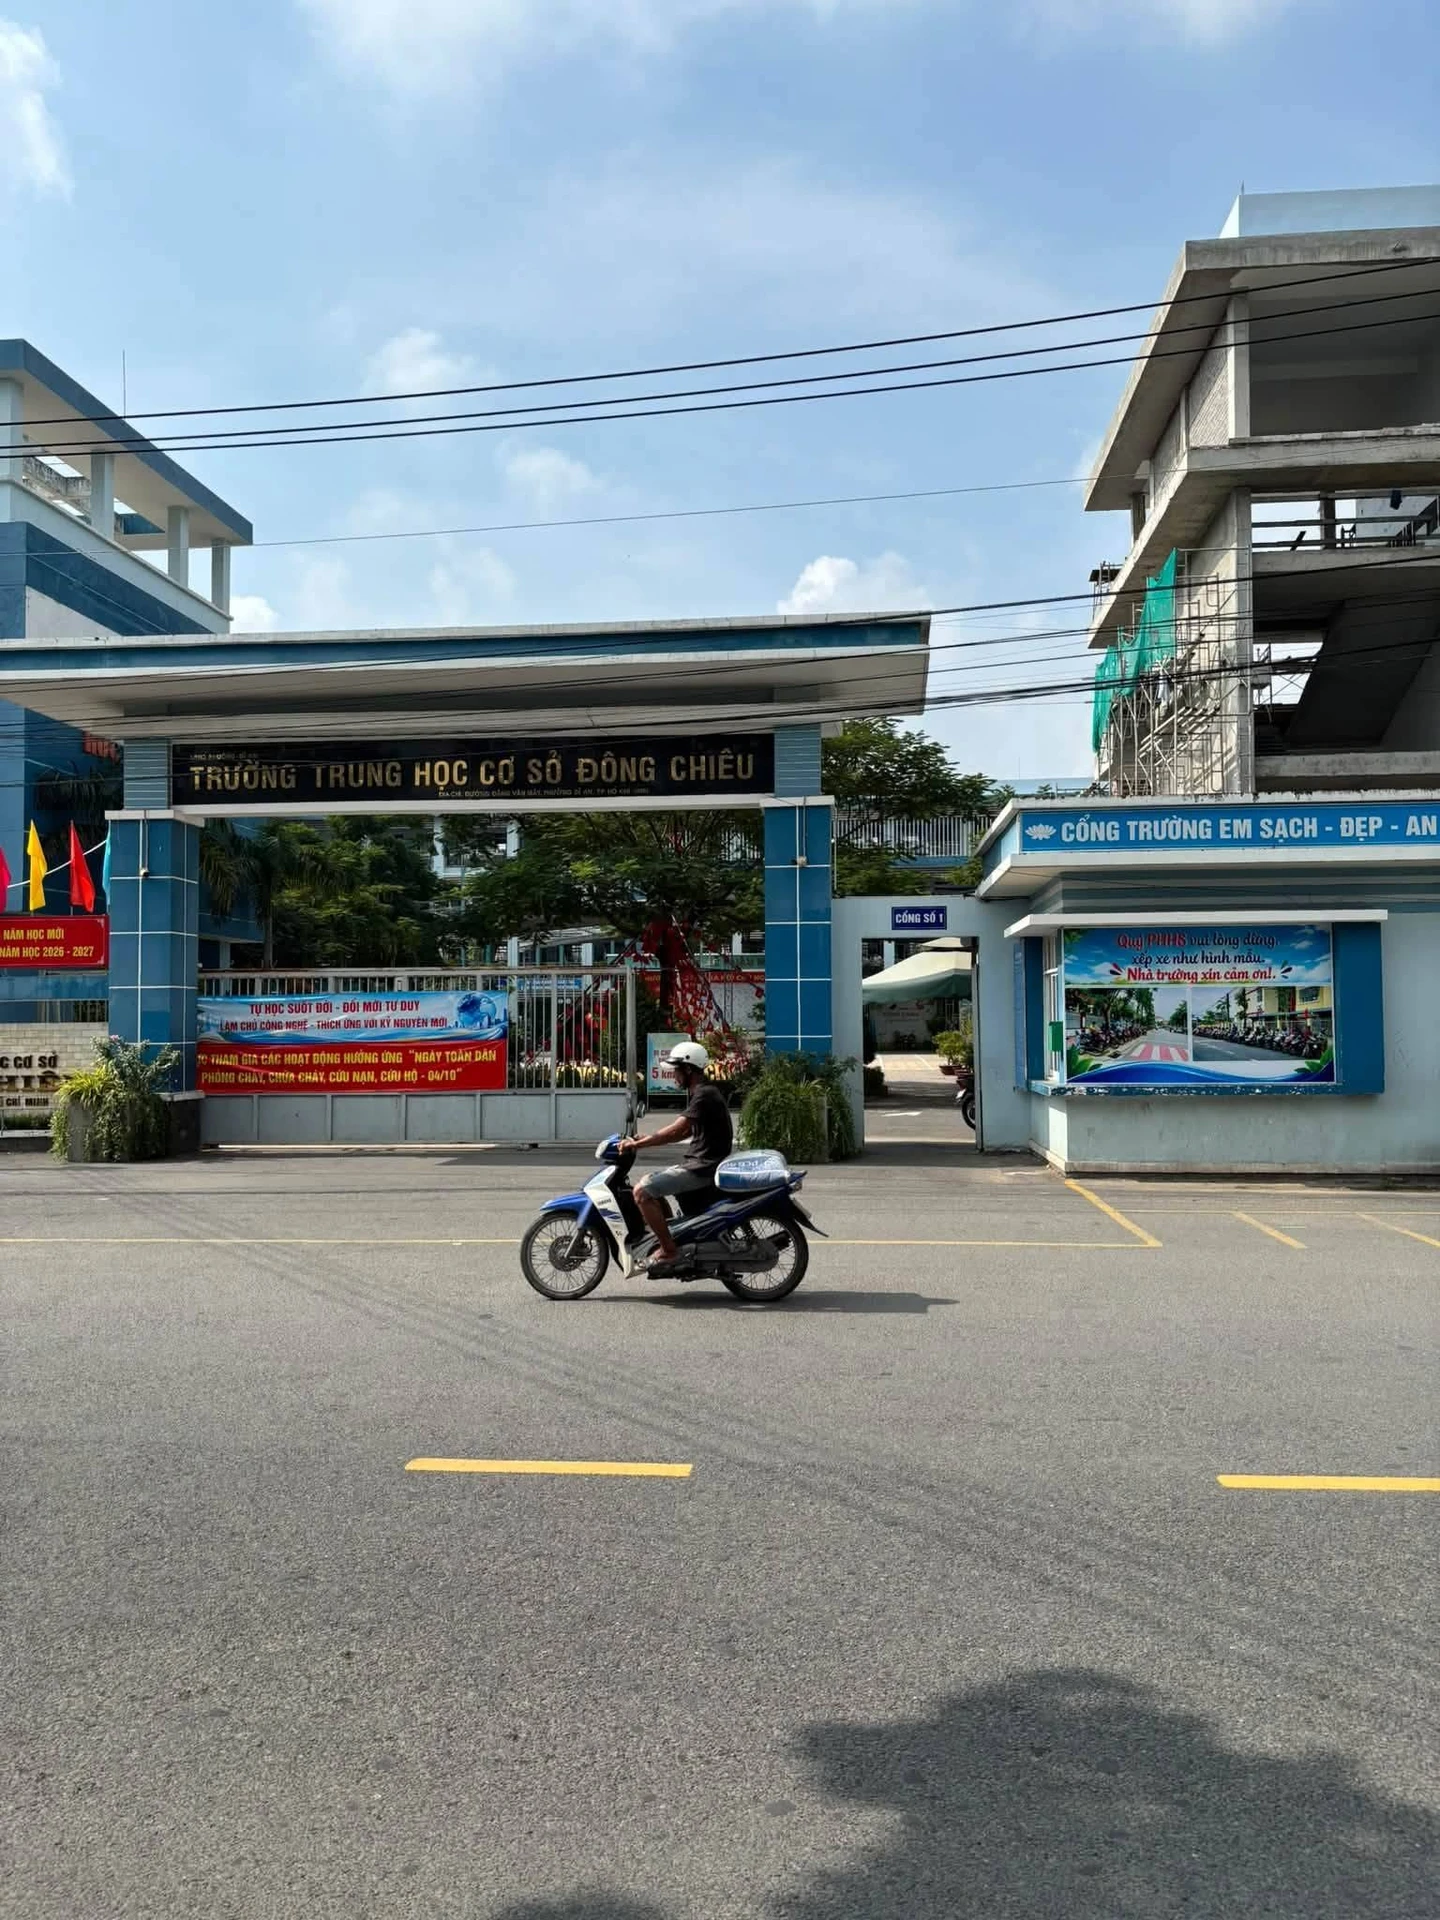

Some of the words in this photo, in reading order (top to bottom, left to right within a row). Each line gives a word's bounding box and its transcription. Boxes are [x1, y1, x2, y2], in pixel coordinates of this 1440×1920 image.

[189, 758, 296, 791] TRƯỜNG
[315, 761, 402, 789] TRUNG
[414, 760, 468, 791] HỌC
[479, 755, 515, 786] CƠ
[527, 749, 562, 785] SỞ
[575, 750, 657, 783] ĐÔNG
[670, 747, 753, 781] CHIÊU
[1060, 813, 1120, 843] CỔNG
[1126, 814, 1212, 841] TRƯỜNG
[1219, 818, 1252, 839] EM
[1259, 817, 1318, 843] SẠCH
[1340, 816, 1383, 842] ĐẸP
[1405, 815, 1437, 836] AN
[895, 909, 921, 924] CỔNG
[923, 909, 936, 924] SỐ
[938, 913, 944, 924] 1
[3, 927, 24, 941] NĂM
[26, 929, 45, 943] HỌC
[47, 926, 65, 941] MỚI
[1117, 933, 1144, 951] Quý
[1147, 932, 1187, 948] PHHS
[1190, 935, 1209, 947] vui
[1211, 931, 1239, 950] lòng
[22, 946, 41, 960] HỌC
[72, 945, 95, 957] 2027
[1131, 949, 1153, 968] xếp
[1156, 955, 1171, 965] xe
[1173, 951, 1199, 964] như
[1201, 949, 1232, 964] hình
[1126, 966, 1154, 982] Nhà
[1156, 968, 1199, 984] trường
[1200, 967, 1222, 981] xin
[1224, 966, 1250, 980] cảm
[249, 1002, 262, 1016] TỰ
[264, 1003, 285, 1016] HỌC
[287, 1001, 313, 1014] SUỐT
[315, 1000, 333, 1013] ĐỜI
[342, 998, 359, 1013] ĐỔI
[362, 999, 382, 1012] MỚI
[385, 1001, 397, 1012] TƯ
[400, 1001, 420, 1012] DUY
[240, 1017, 257, 1031] CHỦ
[259, 1018, 283, 1031] CÔNG
[285, 1018, 308, 1032] NGHỆ
[380, 1015, 392, 1028] KỶ
[393, 1015, 427, 1028] NGUYÊN
[429, 1016, 448, 1028] MỚI
[210, 1053, 239, 1066] THAM
[241, 1053, 258, 1065] GIA
[260, 1051, 282, 1065] CÁC
[284, 1053, 310, 1067] HOẠT
[312, 1051, 341, 1067] ĐỘNG
[343, 1049, 378, 1064] HƯỞNG
[380, 1049, 402, 1063] ỨNG
[445, 1048, 471, 1062] TOÀN
[474, 1049, 496, 1062] DÂN
[201, 1068, 235, 1084] PHÒNG
[328, 1068, 350, 1083] CỨU
[380, 1068, 400, 1083] CỨU
[402, 1067, 417, 1084] HỘ
[652, 1067, 659, 1079] 5
[25, 1097, 49, 1107] MINH
